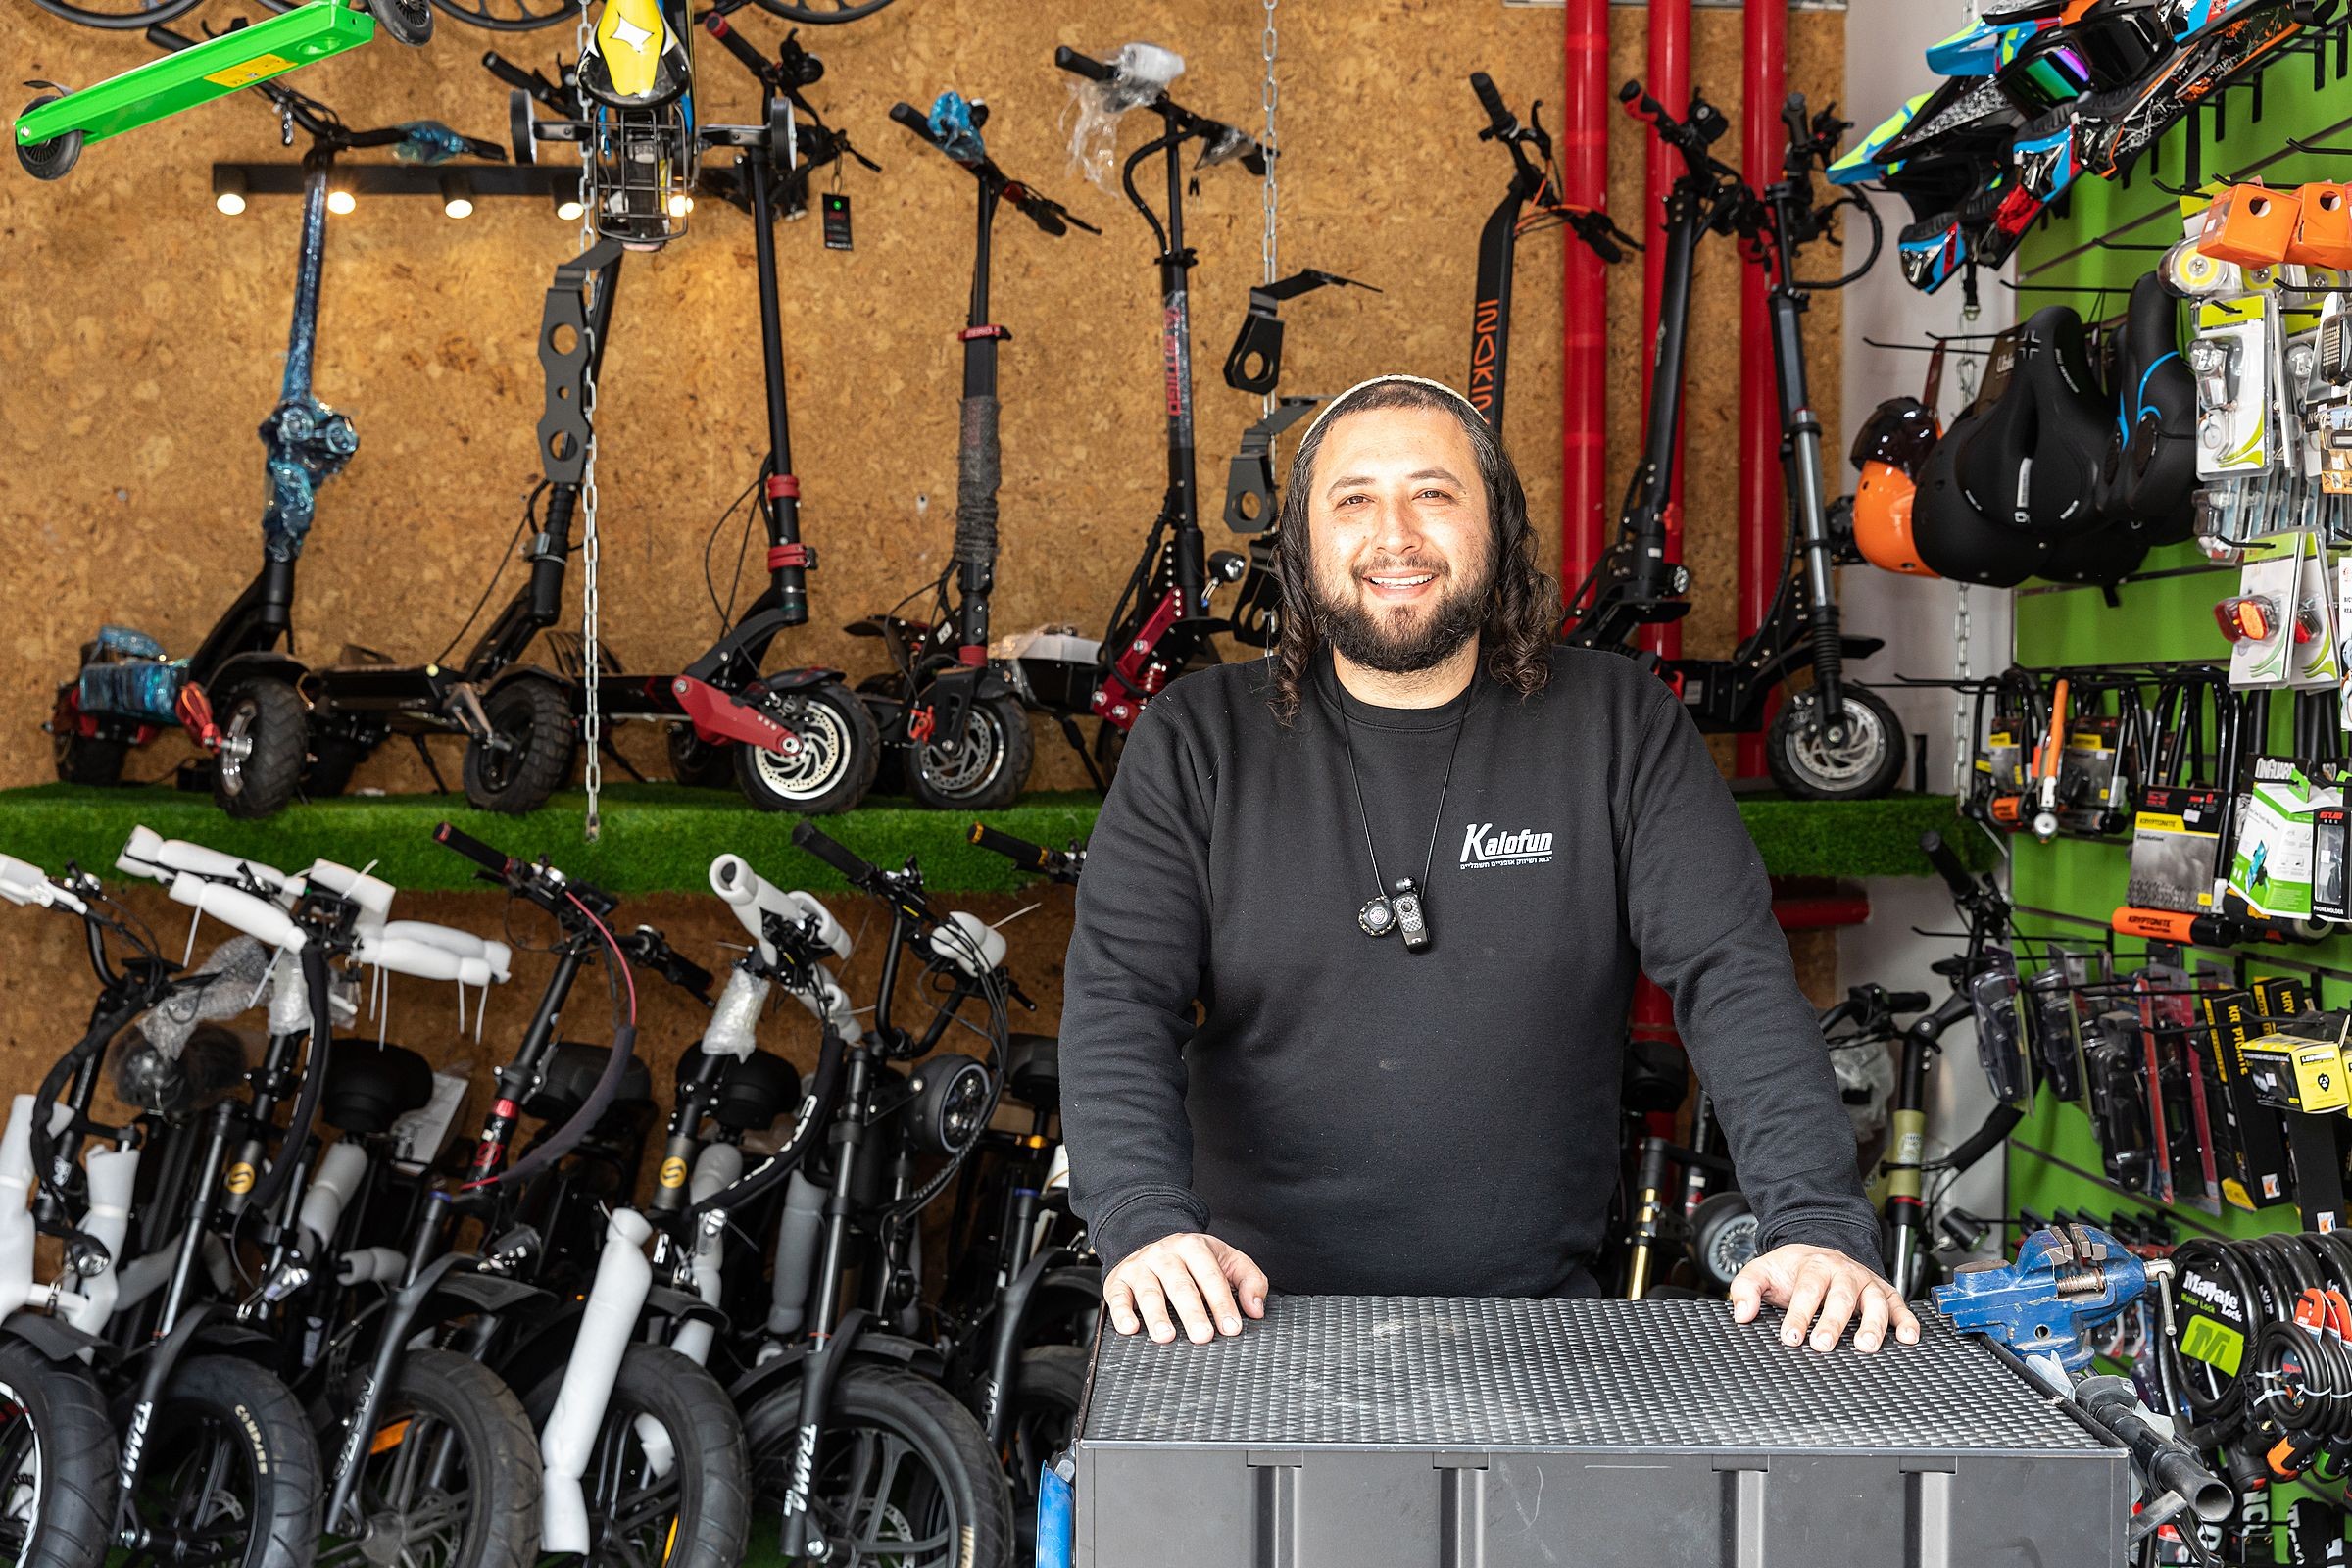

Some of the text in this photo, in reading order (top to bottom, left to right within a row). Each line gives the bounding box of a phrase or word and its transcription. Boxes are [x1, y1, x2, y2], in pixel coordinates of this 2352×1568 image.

[1460, 823, 1553, 863] Kalofun
[1491, 859, 1515, 868] אופניים
[2313, 905, 2344, 915] PHONE HOLDER
[2227, 1004, 2249, 1076] KRPTOITE
[2220, 1304, 2243, 1323] Lock
